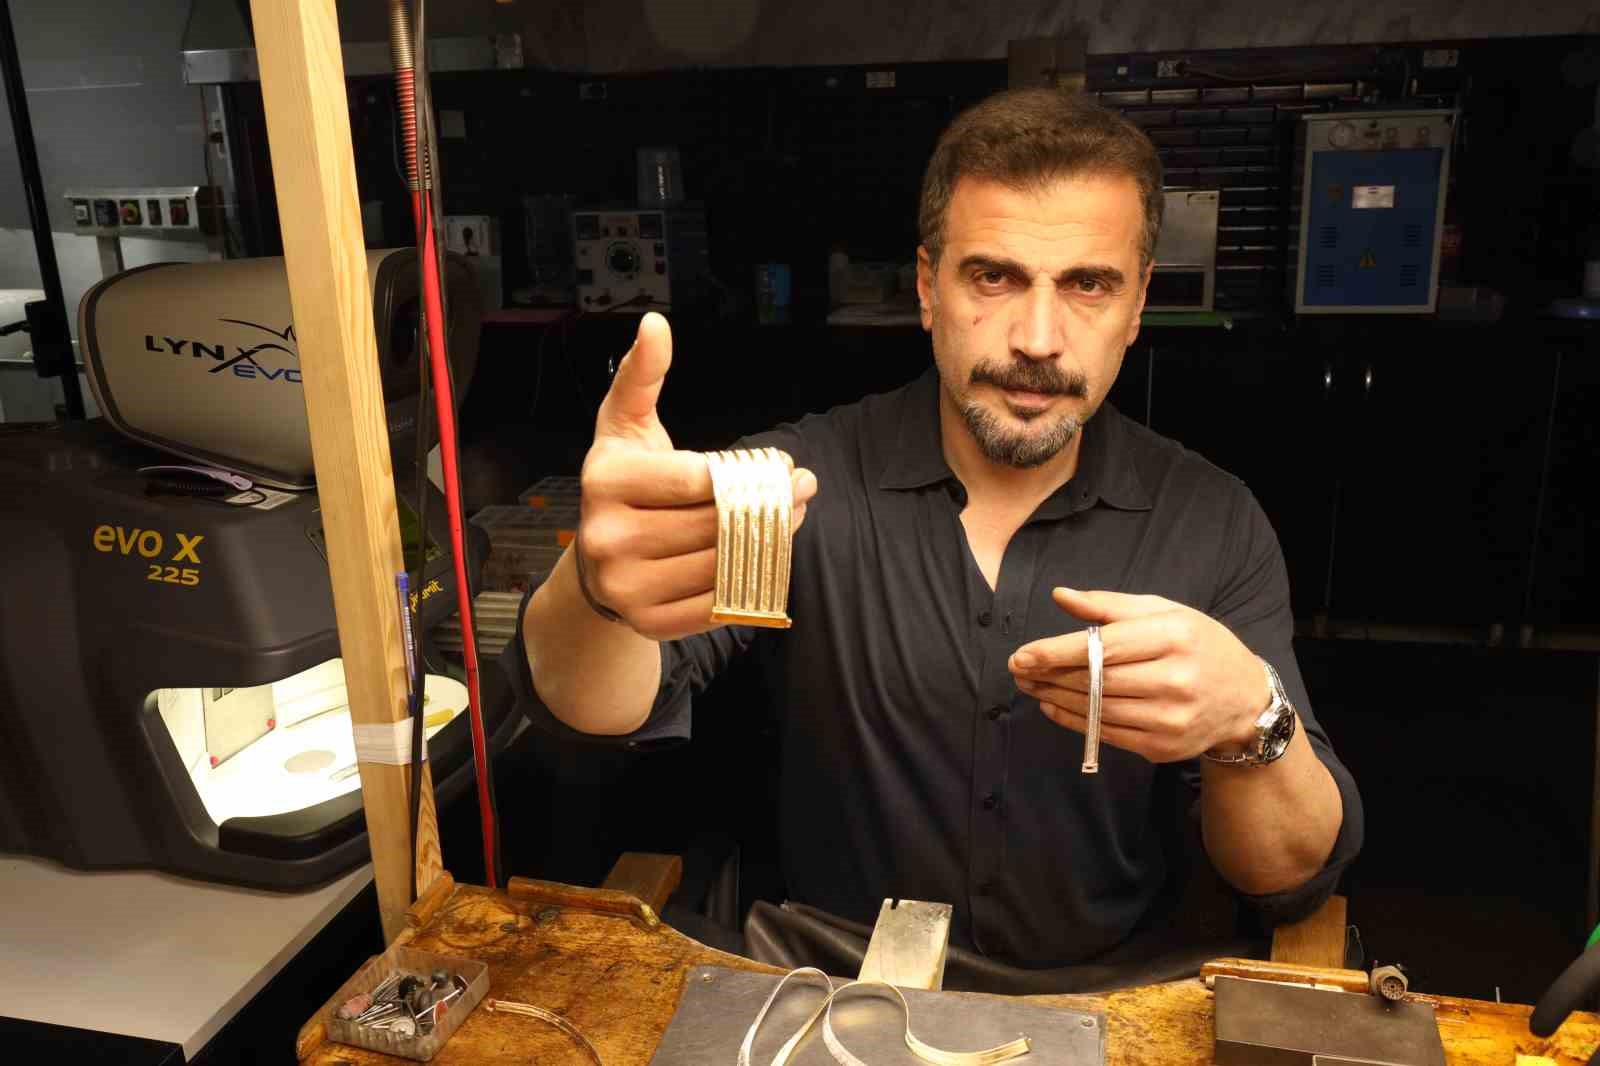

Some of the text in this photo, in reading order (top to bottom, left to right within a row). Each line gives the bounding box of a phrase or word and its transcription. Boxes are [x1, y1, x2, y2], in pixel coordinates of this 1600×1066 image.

[145, 334, 268, 373] LYNX
[93, 524, 163, 558] evo
[147, 564, 200, 586] 225
